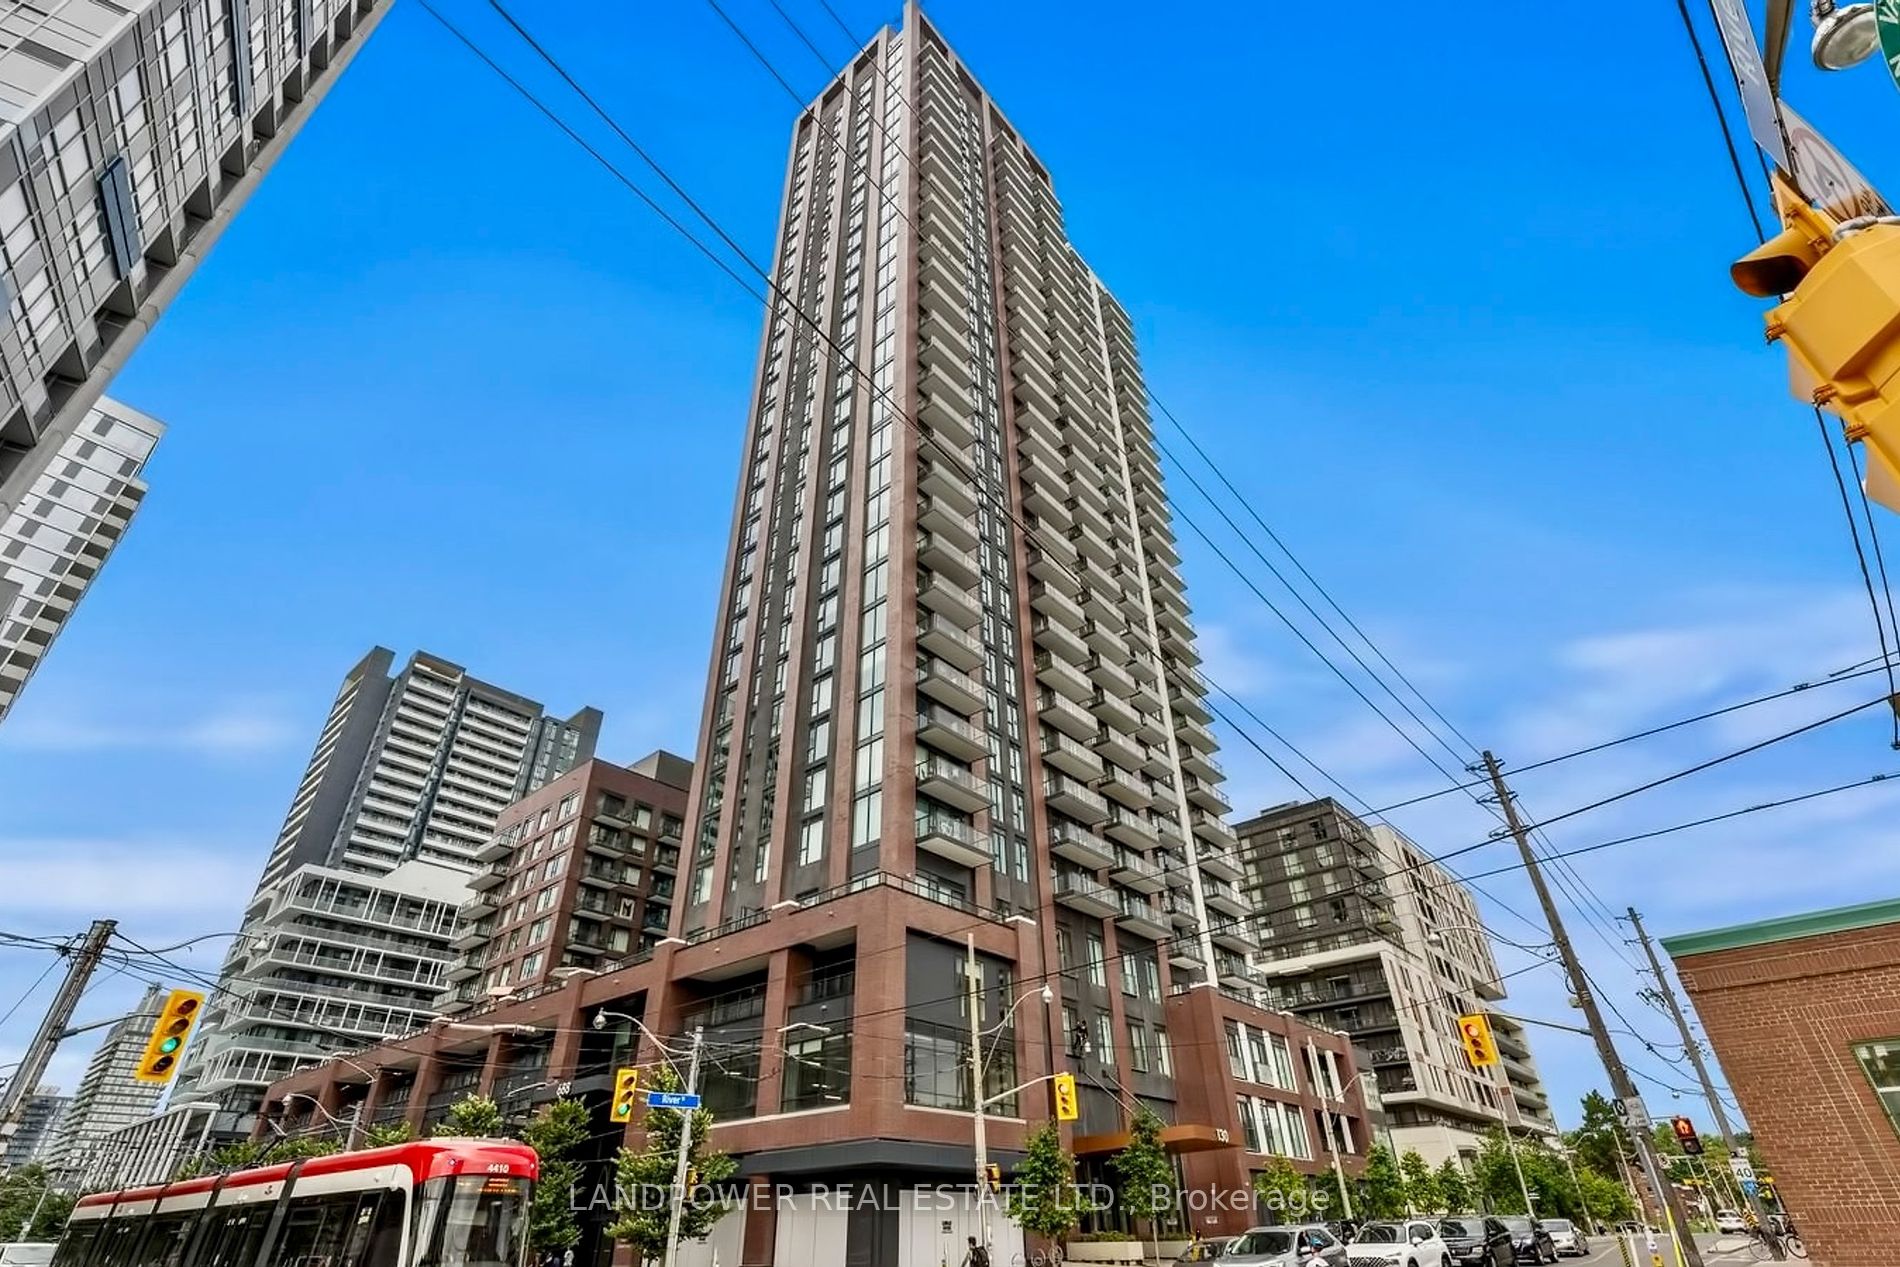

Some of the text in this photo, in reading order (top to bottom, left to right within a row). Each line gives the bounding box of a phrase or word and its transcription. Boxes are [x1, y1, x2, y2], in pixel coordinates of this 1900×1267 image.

[661, 1094, 681, 1105] River
[1215, 1128, 1230, 1143] 130
[487, 1164, 510, 1174] 4410
[1736, 1168, 1752, 1178] 40
